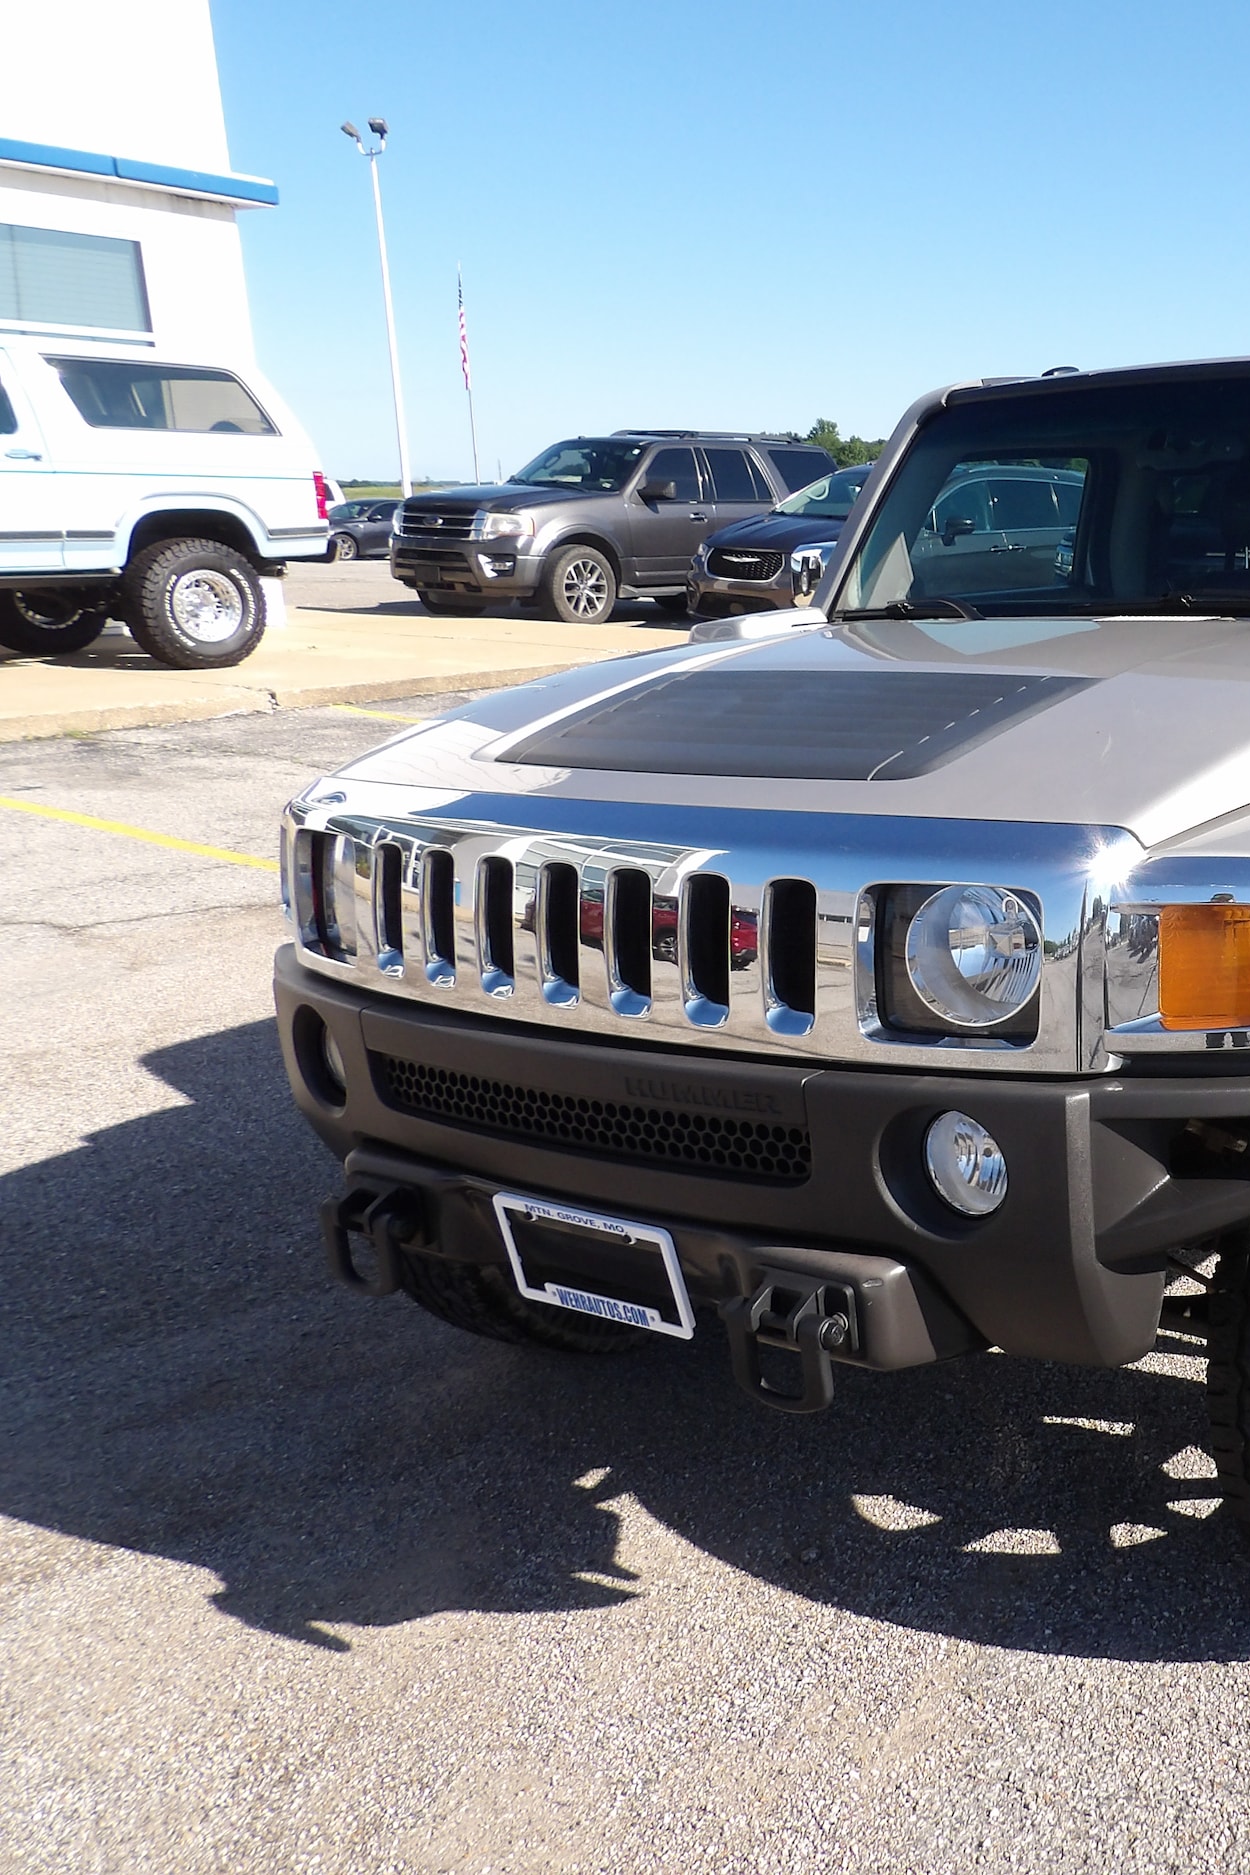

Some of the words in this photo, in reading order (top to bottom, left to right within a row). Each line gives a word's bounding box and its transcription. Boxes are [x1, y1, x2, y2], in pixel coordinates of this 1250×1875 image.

[625, 1076, 782, 1115] HUMMER
[524, 1203, 554, 1217] MTN.
[555, 1287, 651, 1328] WEHRAUTOS.COM
